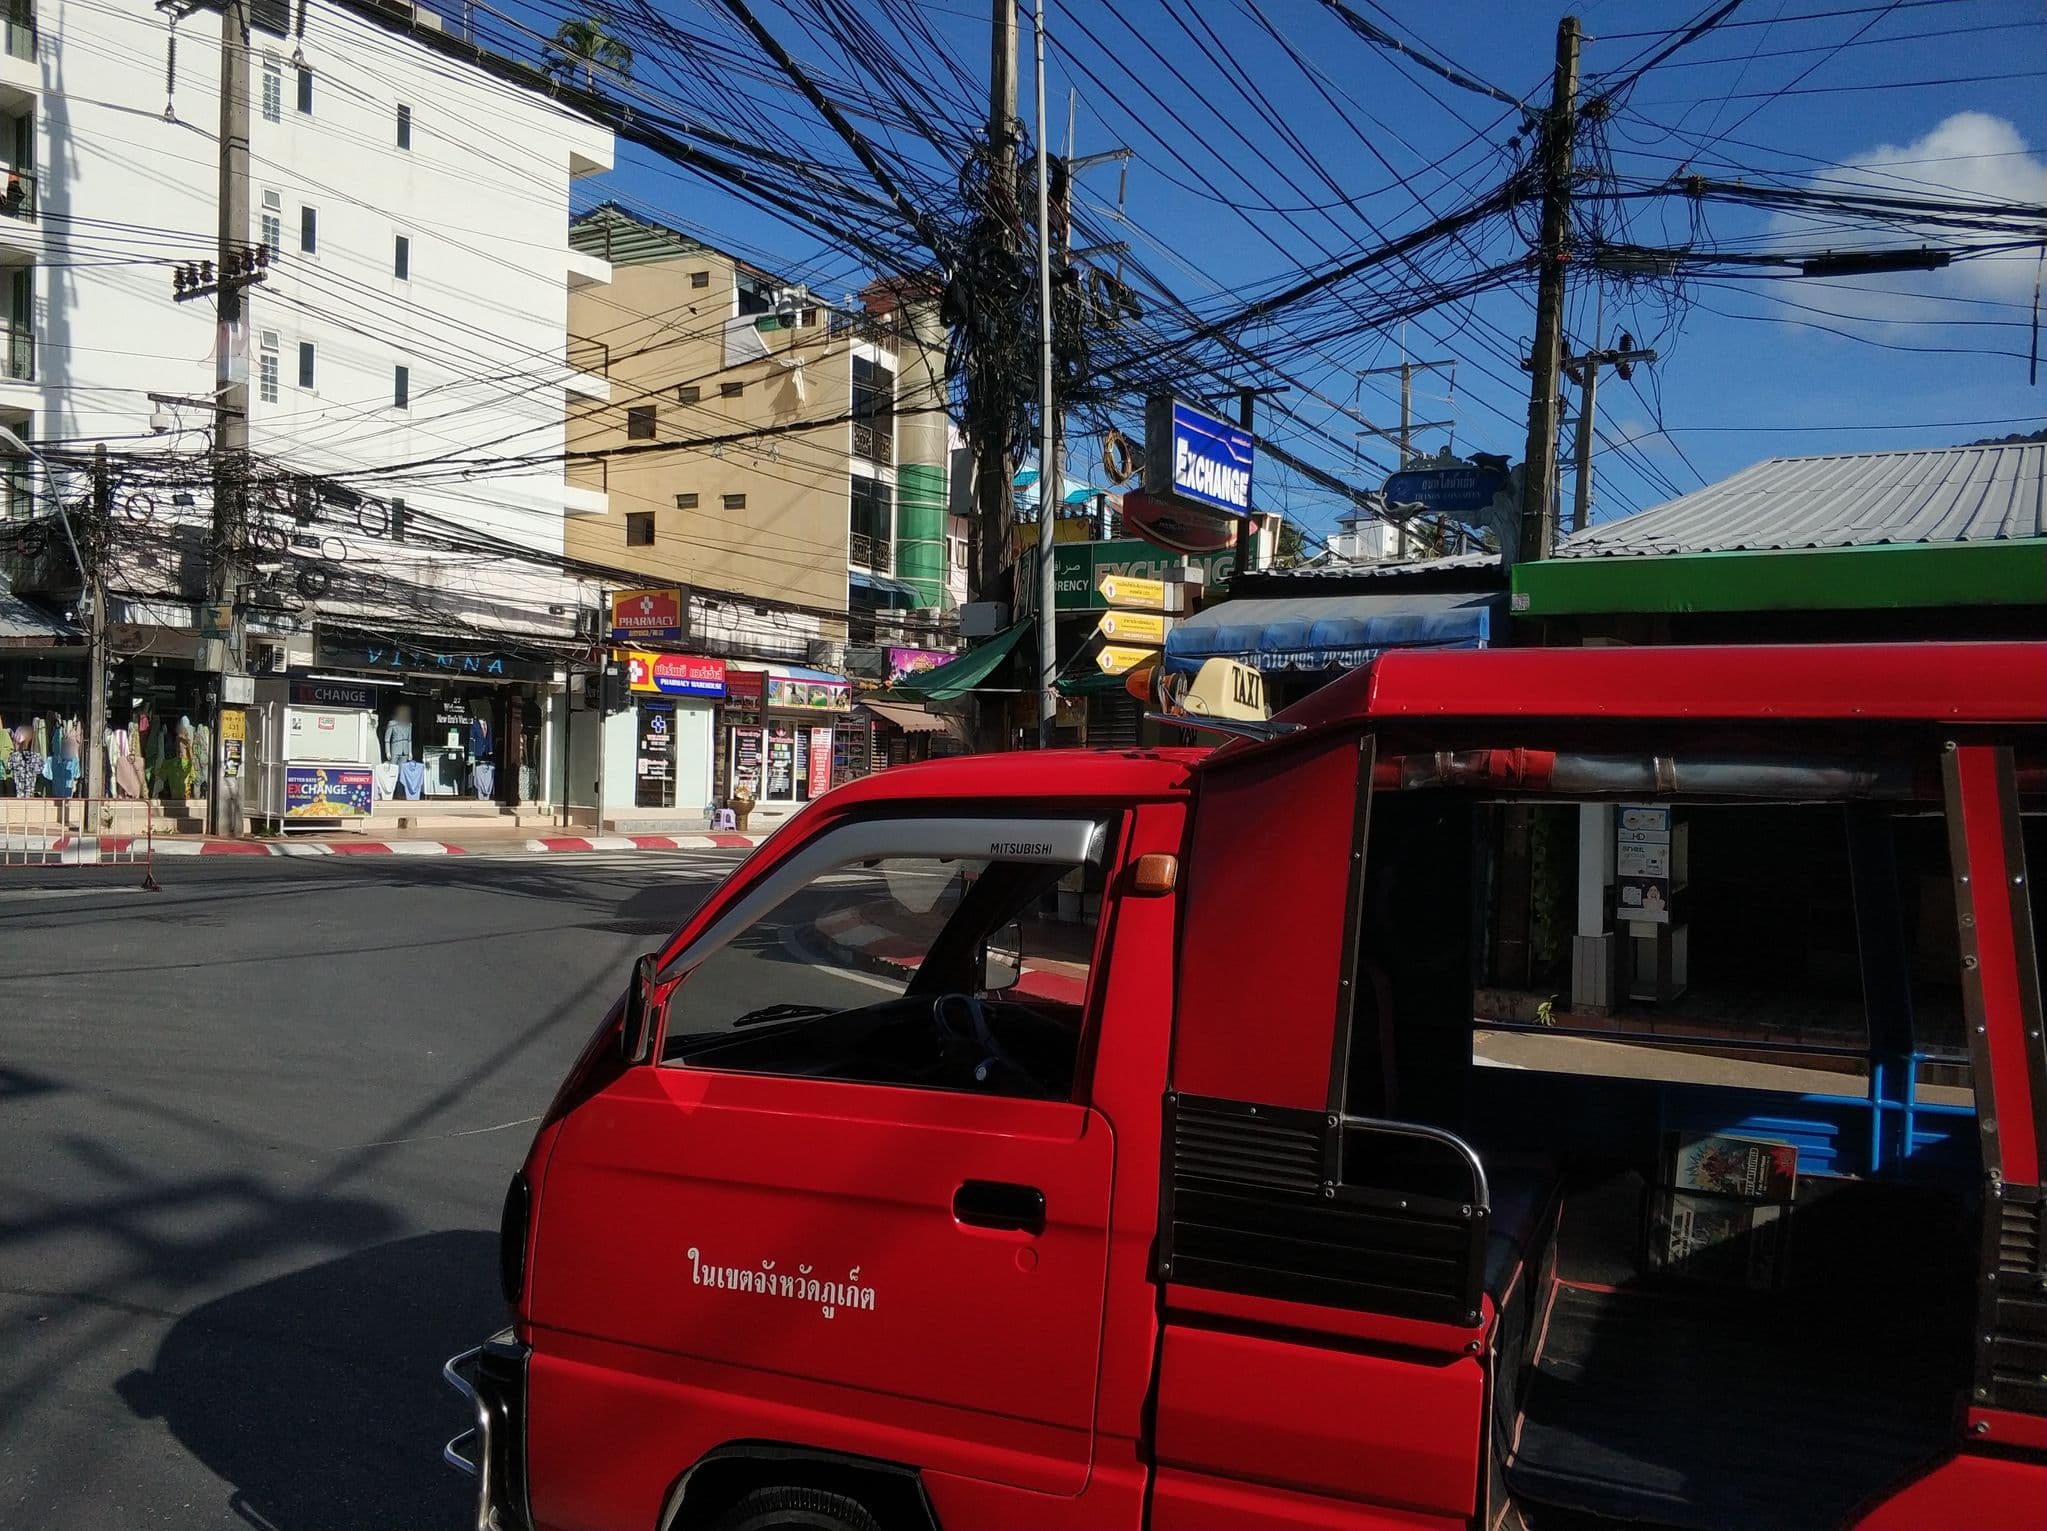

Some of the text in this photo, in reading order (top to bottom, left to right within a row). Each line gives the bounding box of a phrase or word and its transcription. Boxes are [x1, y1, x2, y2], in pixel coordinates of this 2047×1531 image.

[1176, 437, 1250, 507] EXCHANGE
[618, 616, 676, 626] PHARMACY
[660, 678, 689, 687] PHARMACY
[1232, 666, 1260, 710] TAXI
[288, 784, 348, 795] EXCHANGE
[990, 843, 1052, 855] MITSUBISHI
[687, 1247, 875, 1319] ในเขตจังหวัดภูเก็ต
